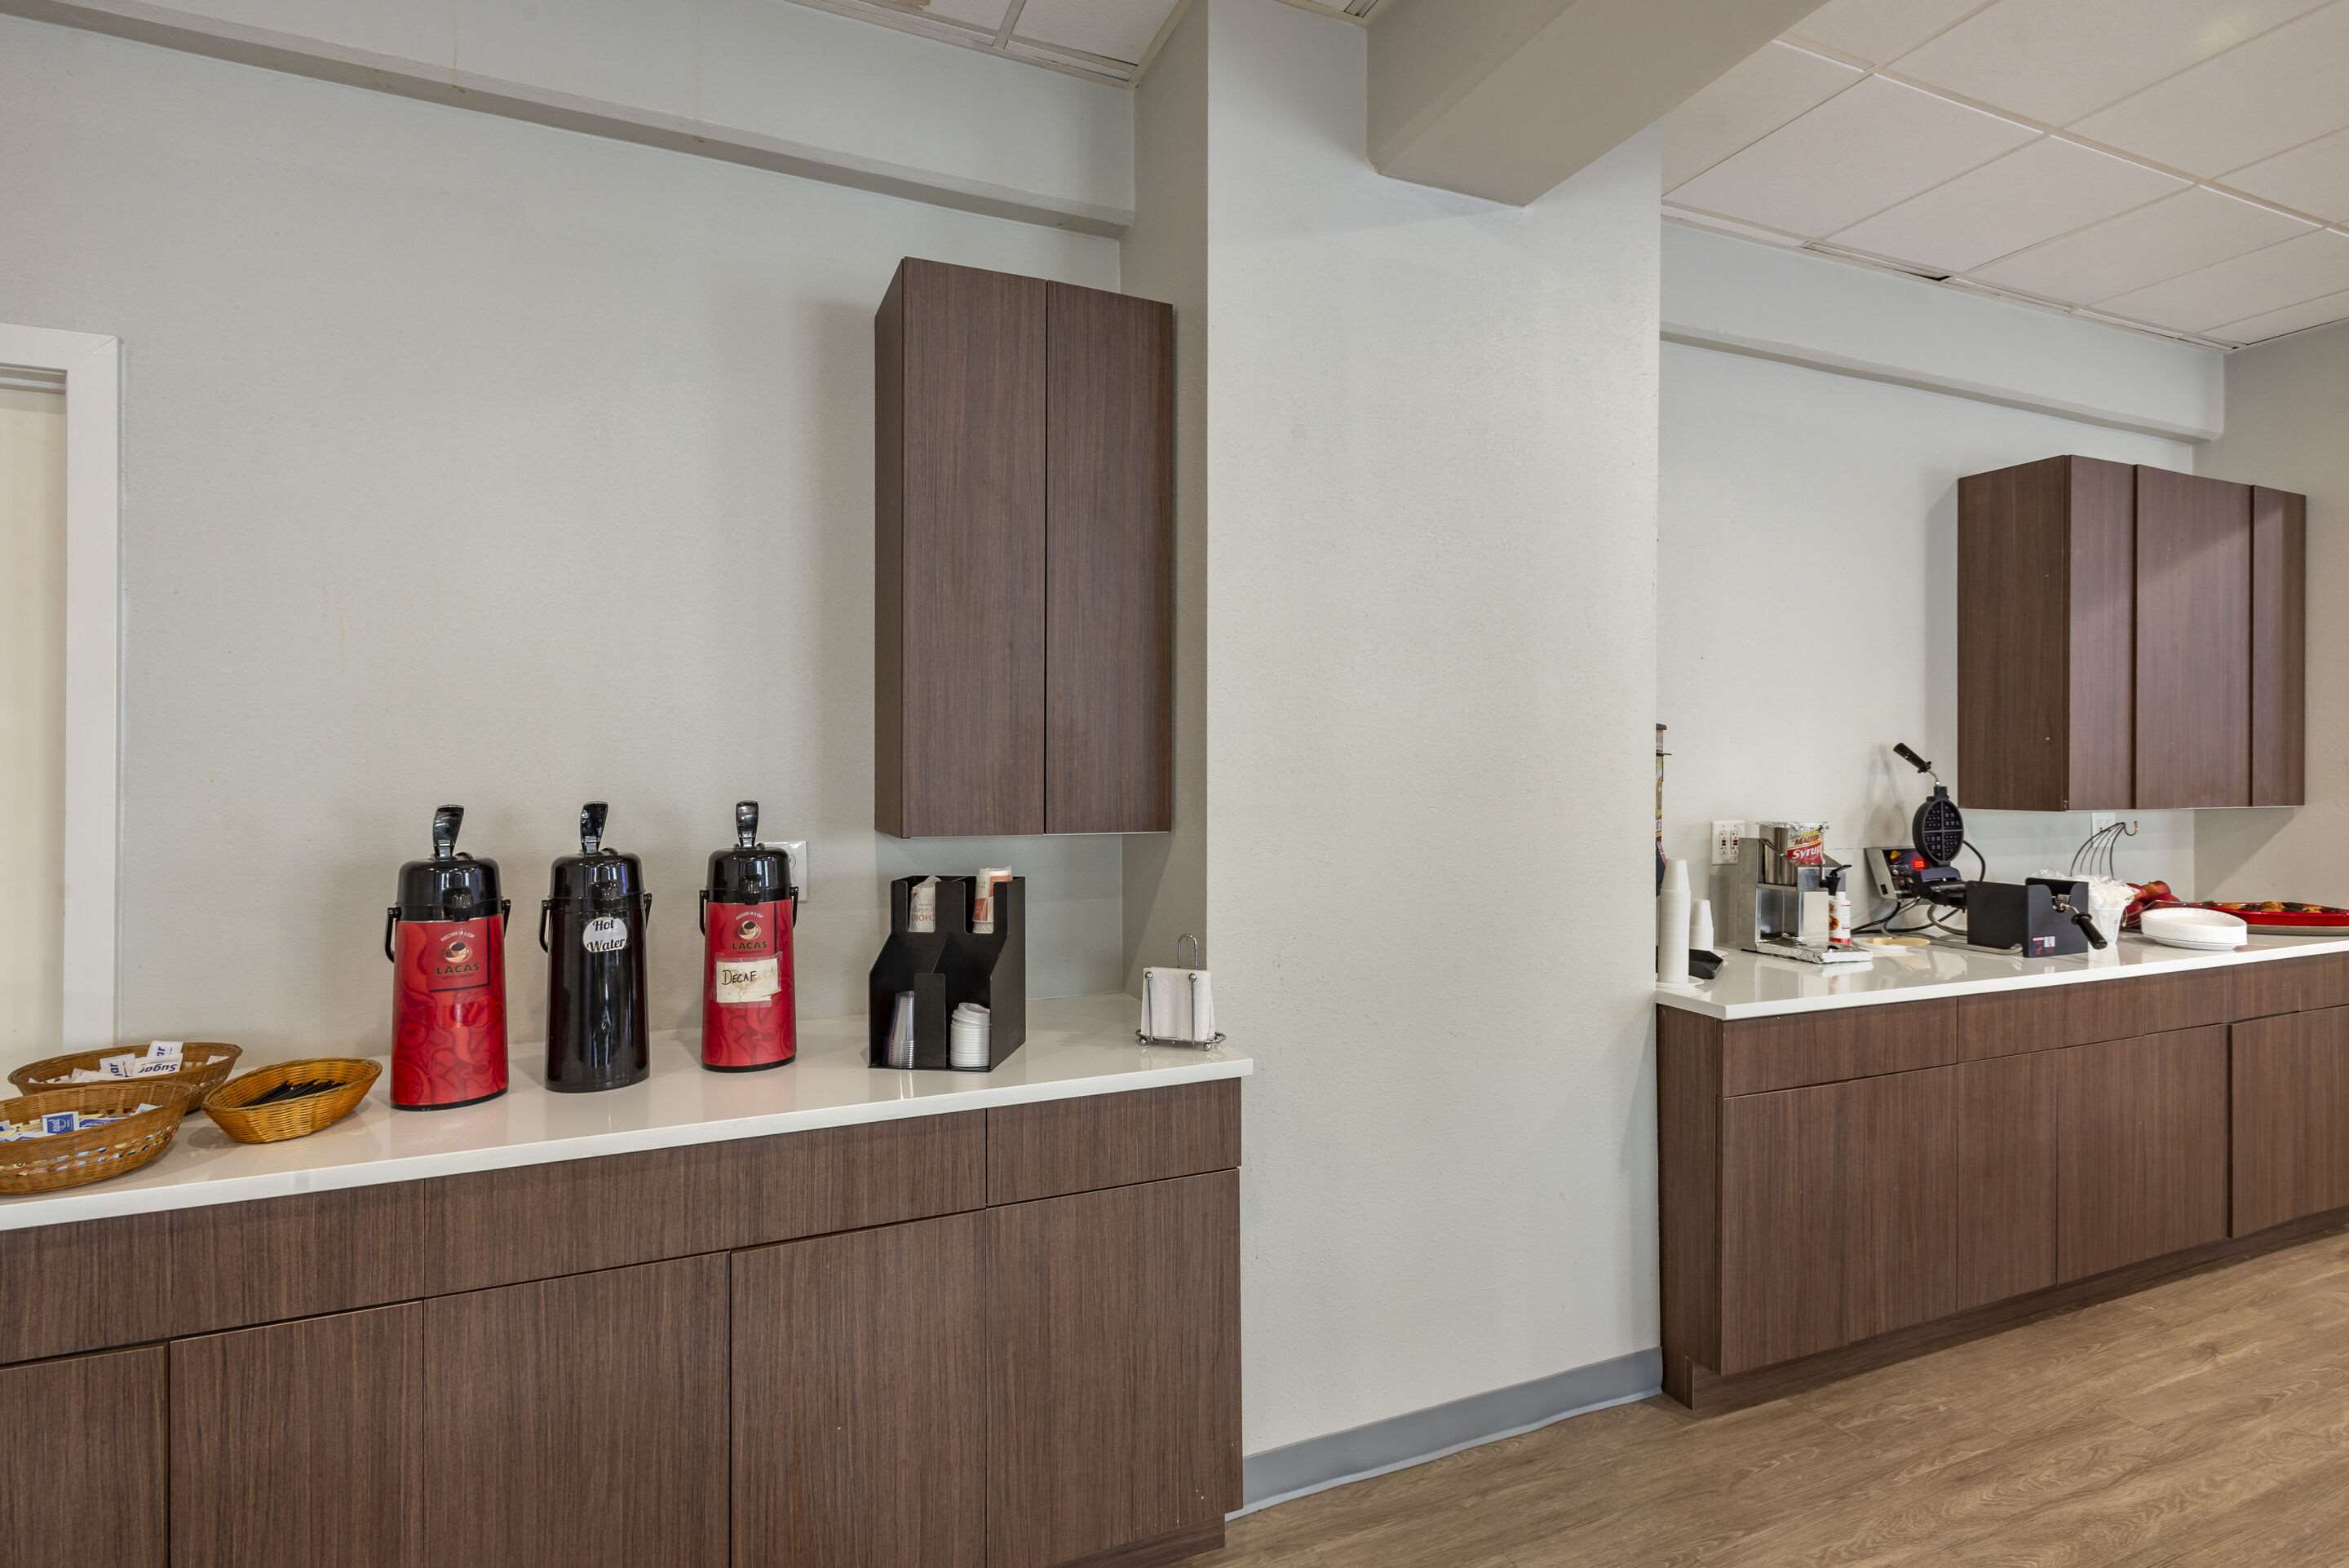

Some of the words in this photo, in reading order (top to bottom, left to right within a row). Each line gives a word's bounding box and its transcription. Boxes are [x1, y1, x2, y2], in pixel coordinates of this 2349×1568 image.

[593, 919, 614, 932] Hot
[586, 939, 626, 952] Water
[732, 940, 768, 950] LACAS
[436, 964, 480, 975] LACAS
[721, 970, 758, 986] DECAF
[138, 1063, 178, 1074] Sugar
